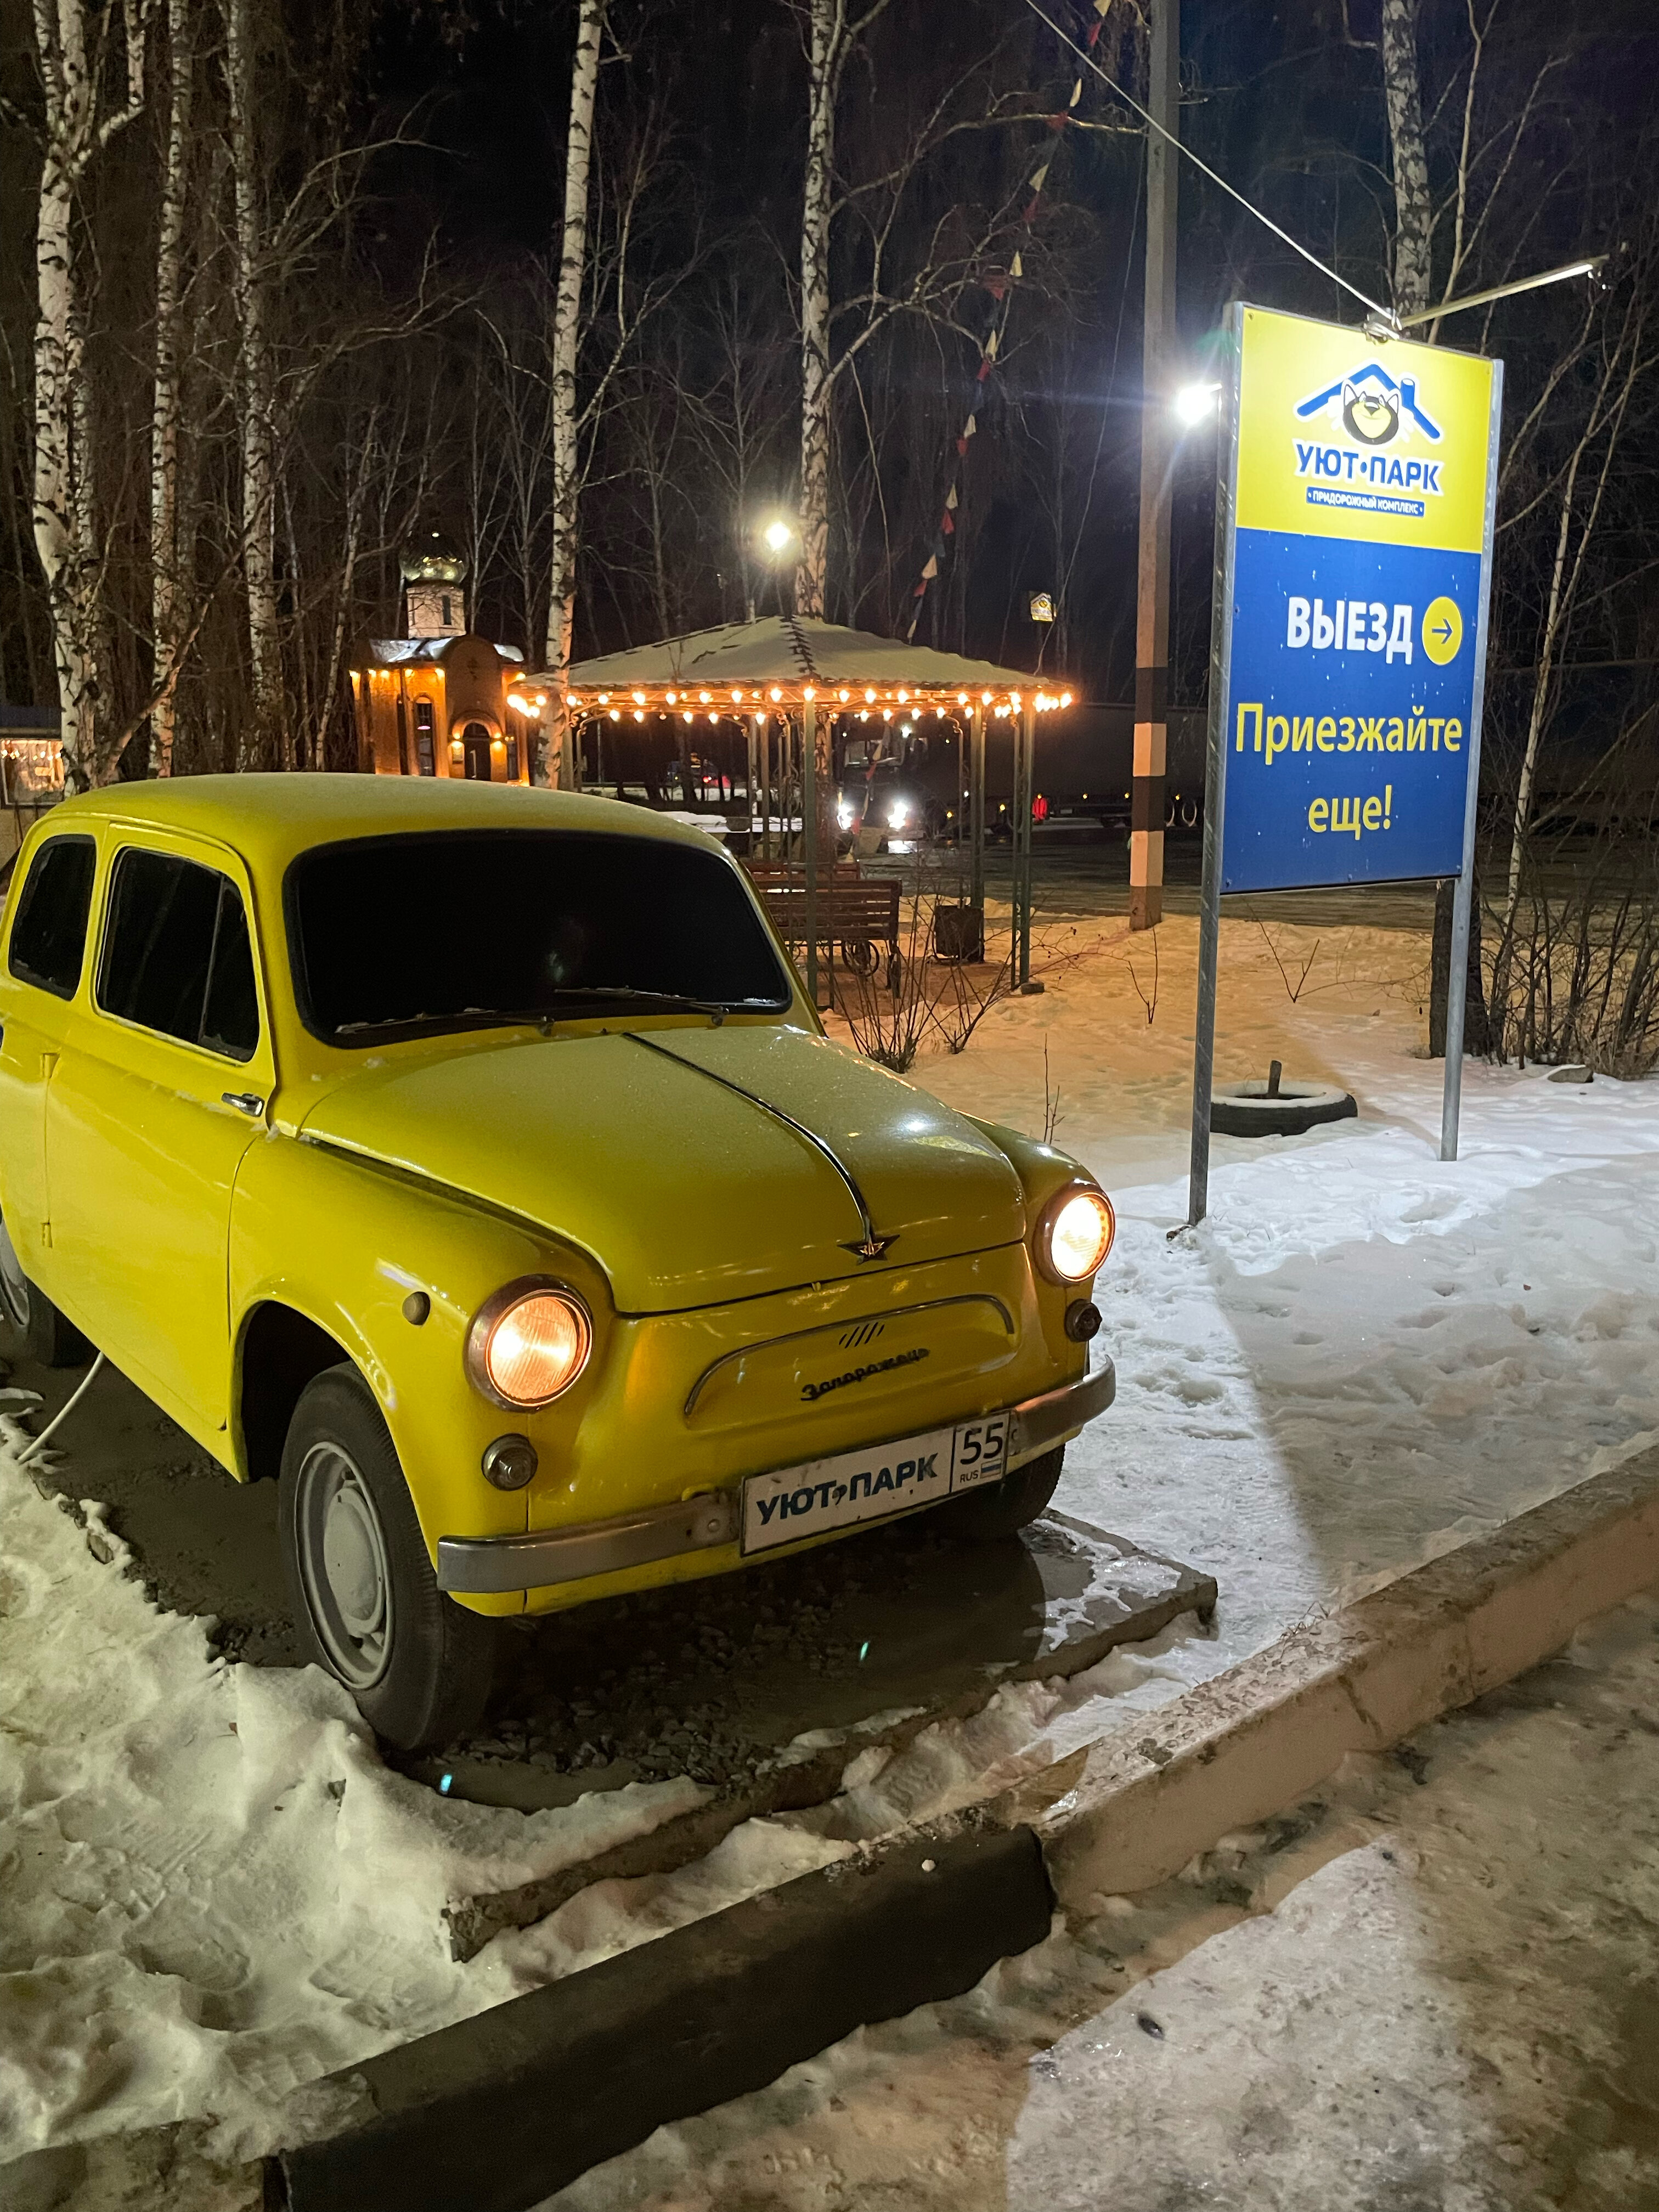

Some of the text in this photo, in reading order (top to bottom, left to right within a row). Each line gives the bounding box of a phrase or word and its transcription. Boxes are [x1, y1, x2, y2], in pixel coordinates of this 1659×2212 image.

[1287, 596, 1413, 664] ВЫЕЗД
[1236, 703, 1462, 765] Приезжайте
[1308, 785, 1392, 840] еще!
[960, 1422, 1003, 1465] 55
[960, 1469, 979, 1483] RUS
